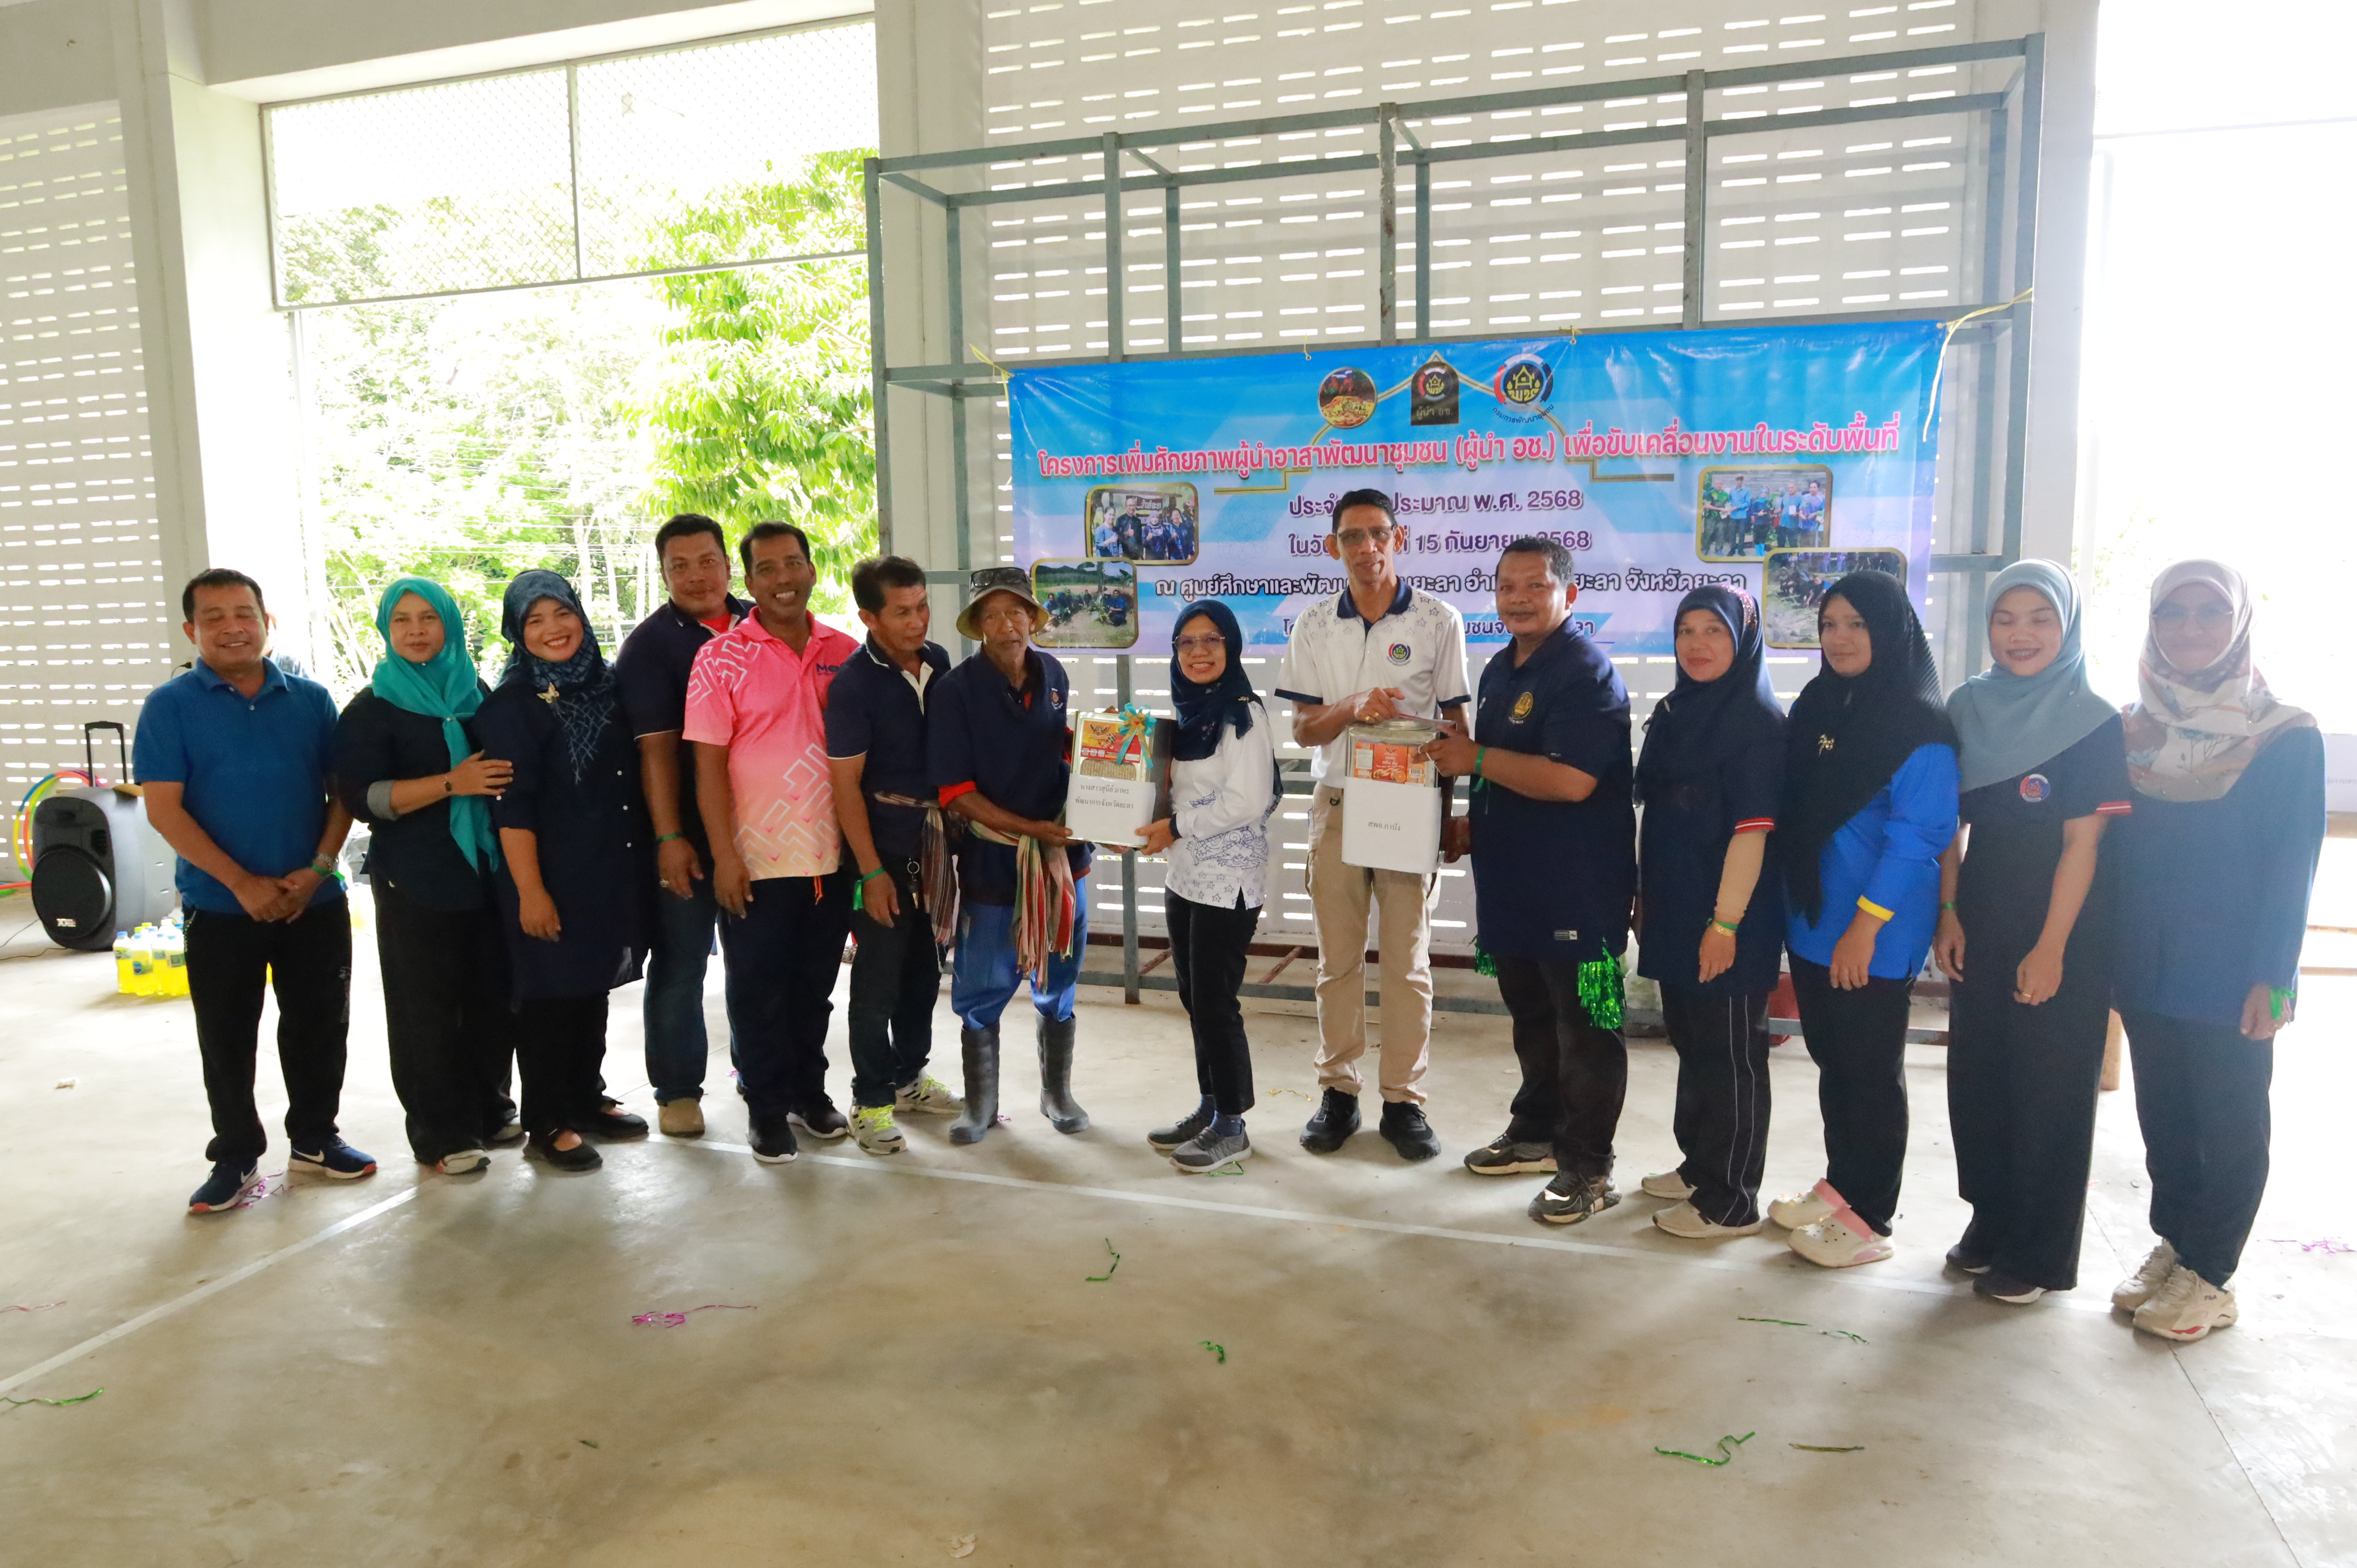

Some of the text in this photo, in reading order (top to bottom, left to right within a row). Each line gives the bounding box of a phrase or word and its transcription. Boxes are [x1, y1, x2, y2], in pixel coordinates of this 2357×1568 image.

[1038, 438, 1448, 479] โครงการเพิ่มศักยภาพผู้นำอาสาพัฒนาชุมชน
[1564, 411, 1901, 456] เพื่อขับเคลื่อนงานในระดับพื้นที่
[1475, 492, 1521, 510] พ.ศ.
[1527, 489, 1584, 510] 2568
[1415, 534, 1439, 551] 15
[1155, 579, 1176, 596] ณ
